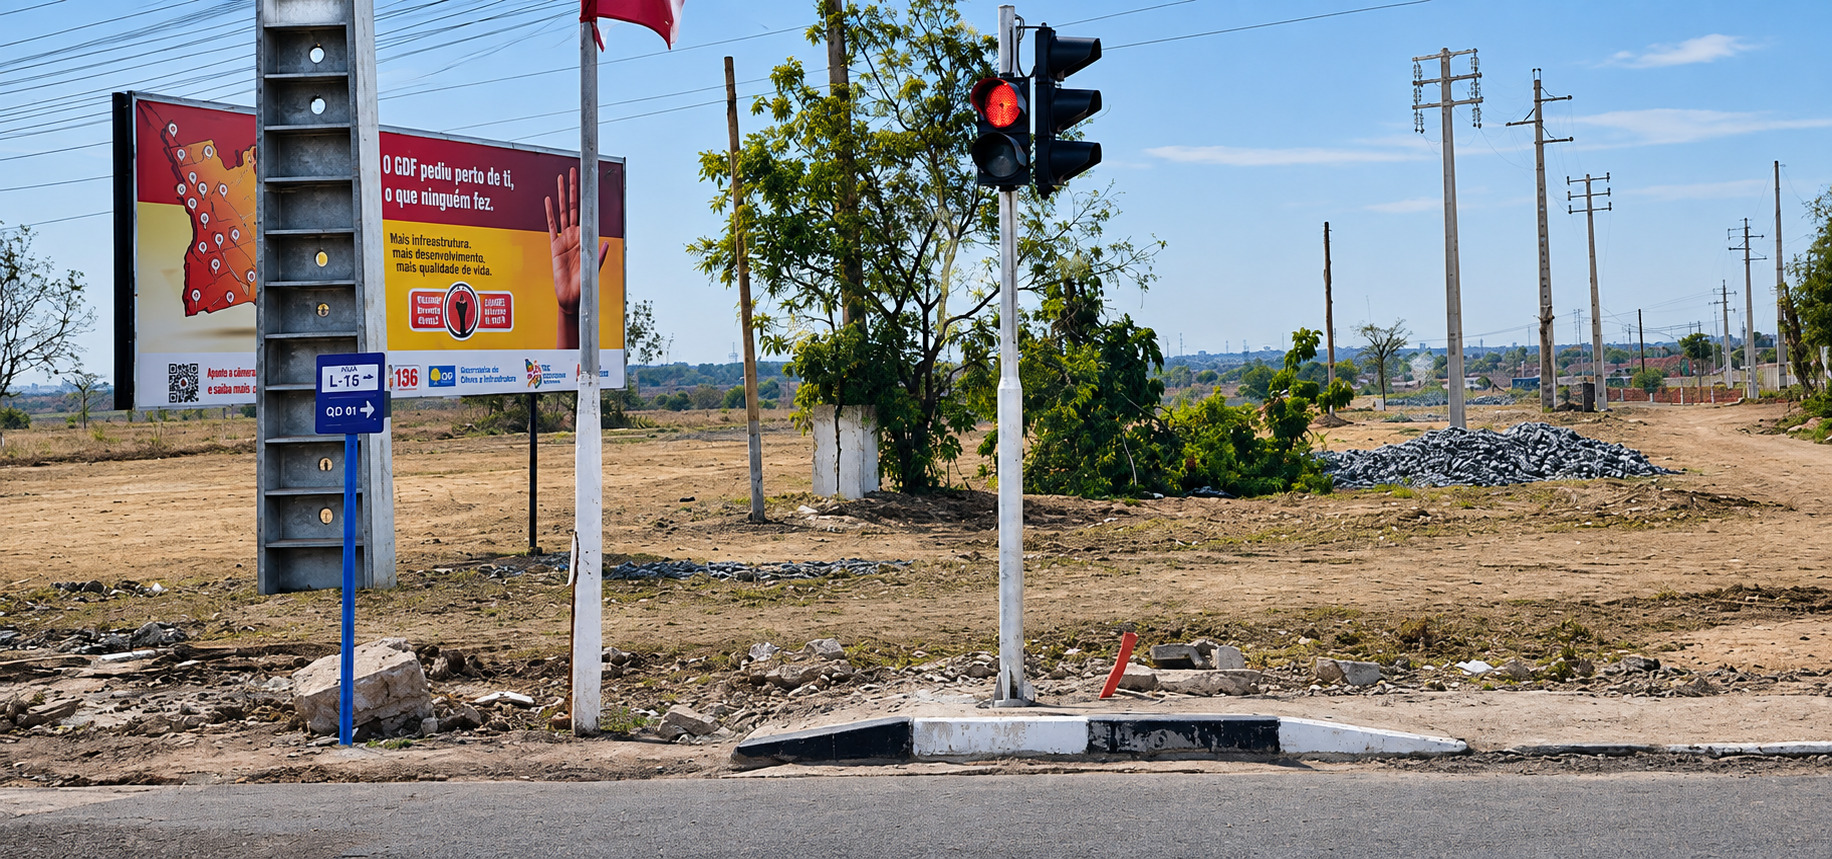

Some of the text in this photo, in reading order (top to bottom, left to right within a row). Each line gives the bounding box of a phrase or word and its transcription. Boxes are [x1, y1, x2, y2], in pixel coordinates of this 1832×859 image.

[383, 154, 515, 191] O GDF pediu perto de ti,
[385, 187, 494, 212] o que ninguém fez.
[389, 232, 410, 246] Mais
[392, 248, 413, 259] mais
[396, 261, 492, 277] mais qualidade de vida.
[207, 385, 213, 395] e
[325, 406, 357, 418] QD 01
